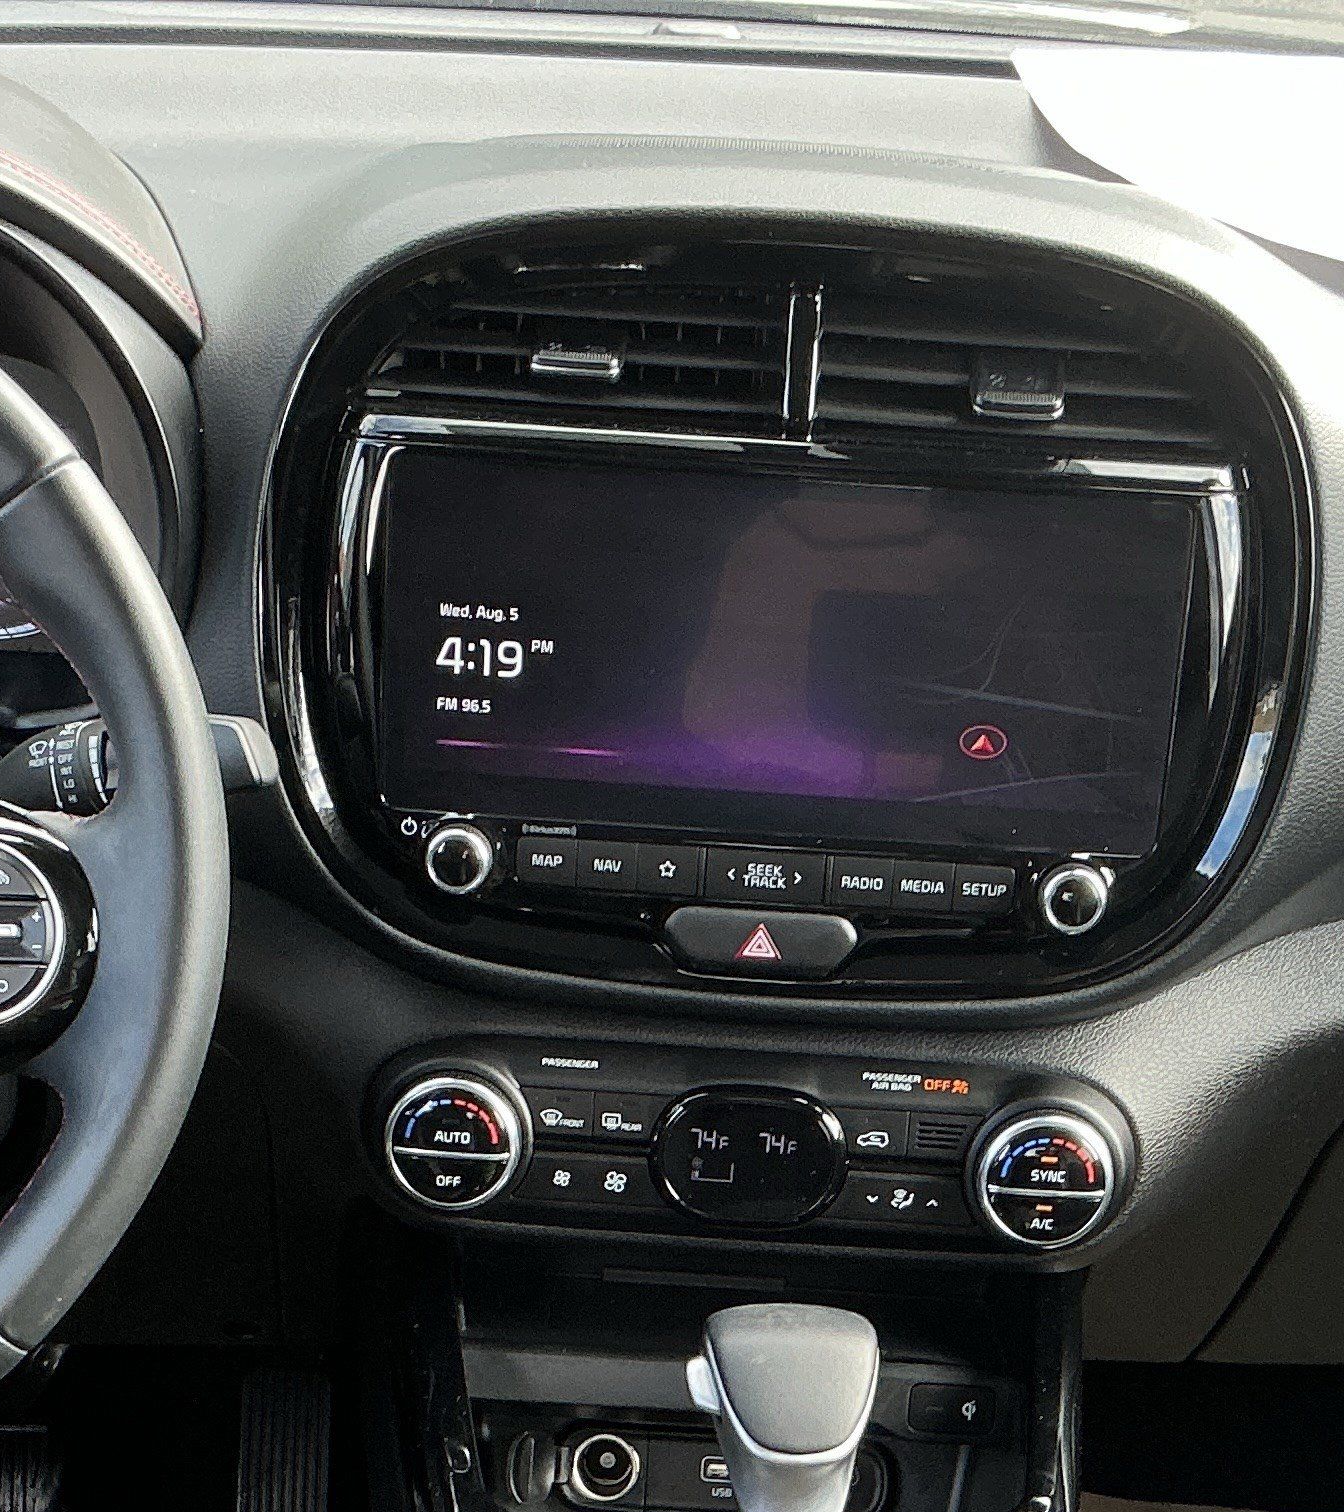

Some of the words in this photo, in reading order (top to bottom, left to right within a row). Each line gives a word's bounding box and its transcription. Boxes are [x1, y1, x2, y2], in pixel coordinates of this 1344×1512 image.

[439, 602, 473, 619] Wed.
[475, 605, 507, 622] Aug.
[509, 607, 519, 621] 5
[436, 636, 523, 678] 4:19
[531, 639, 554, 654] PM
[436, 697, 458, 711] FM
[461, 699, 491, 714] 96.5
[531, 853, 563, 868] MAP
[593, 858, 622, 873] NAV
[747, 863, 783, 876] SEEK
[742, 874, 787, 890] TRACK
[841, 876, 883, 891] RADIO
[900, 879, 945, 894] MEDIA
[962, 882, 1007, 897] SETUP
[862, 1071, 922, 1084] PASSENGER
[924, 1079, 951, 1092] OFF
[434, 1130, 471, 1145] AUTO
[436, 1175, 462, 1187] OFF
[1030, 1169, 1067, 1183] SYNC
[1030, 1218, 1054, 1231] A/C
[711, 1487, 733, 1498] USB
